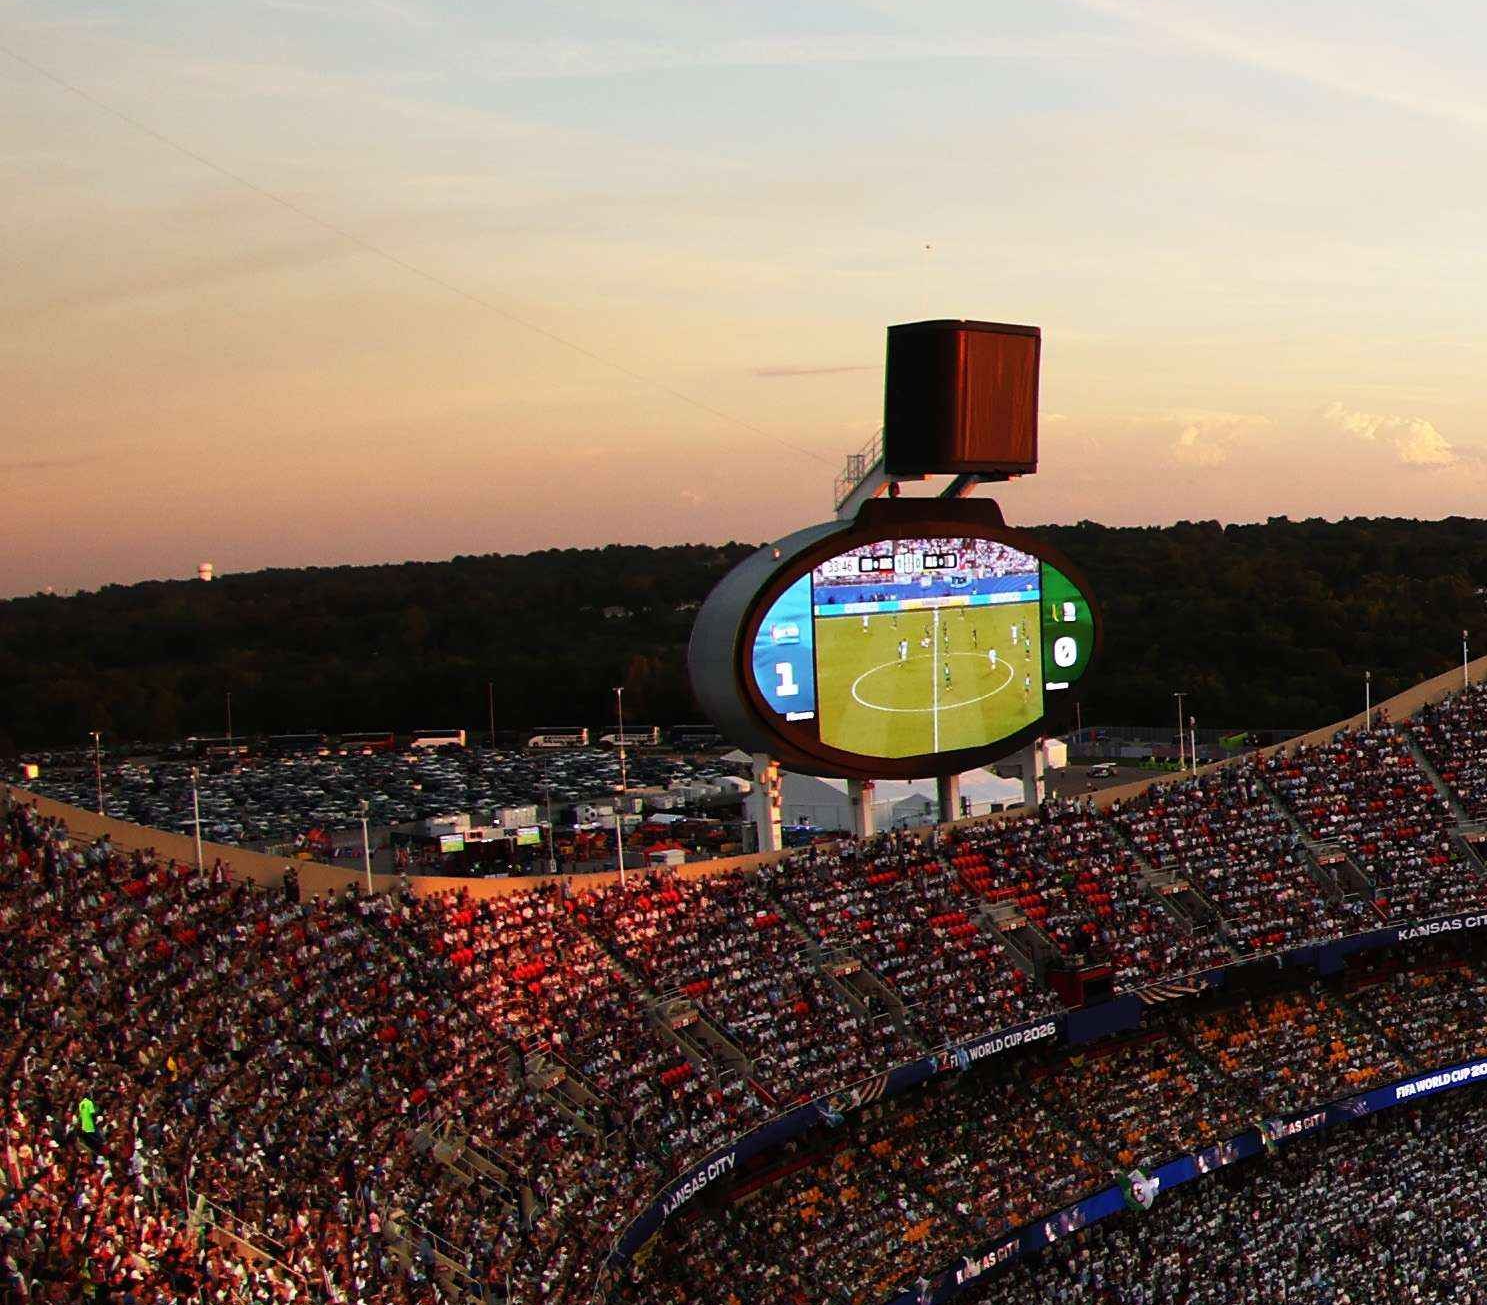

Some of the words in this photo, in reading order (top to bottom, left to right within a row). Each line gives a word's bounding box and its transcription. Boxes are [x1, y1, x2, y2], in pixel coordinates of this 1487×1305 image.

[775, 662, 799, 696] 1
[1398, 918, 1462, 941] KANSAS
[1004, 1032, 1023, 1048] CUP
[1023, 1022, 1056, 1043] 2026
[1395, 1083, 1416, 1099] FIFA
[1416, 1074, 1450, 1092] WORLD
[1451, 1067, 1470, 1083] CUP
[708, 1152, 736, 1181] CITY
